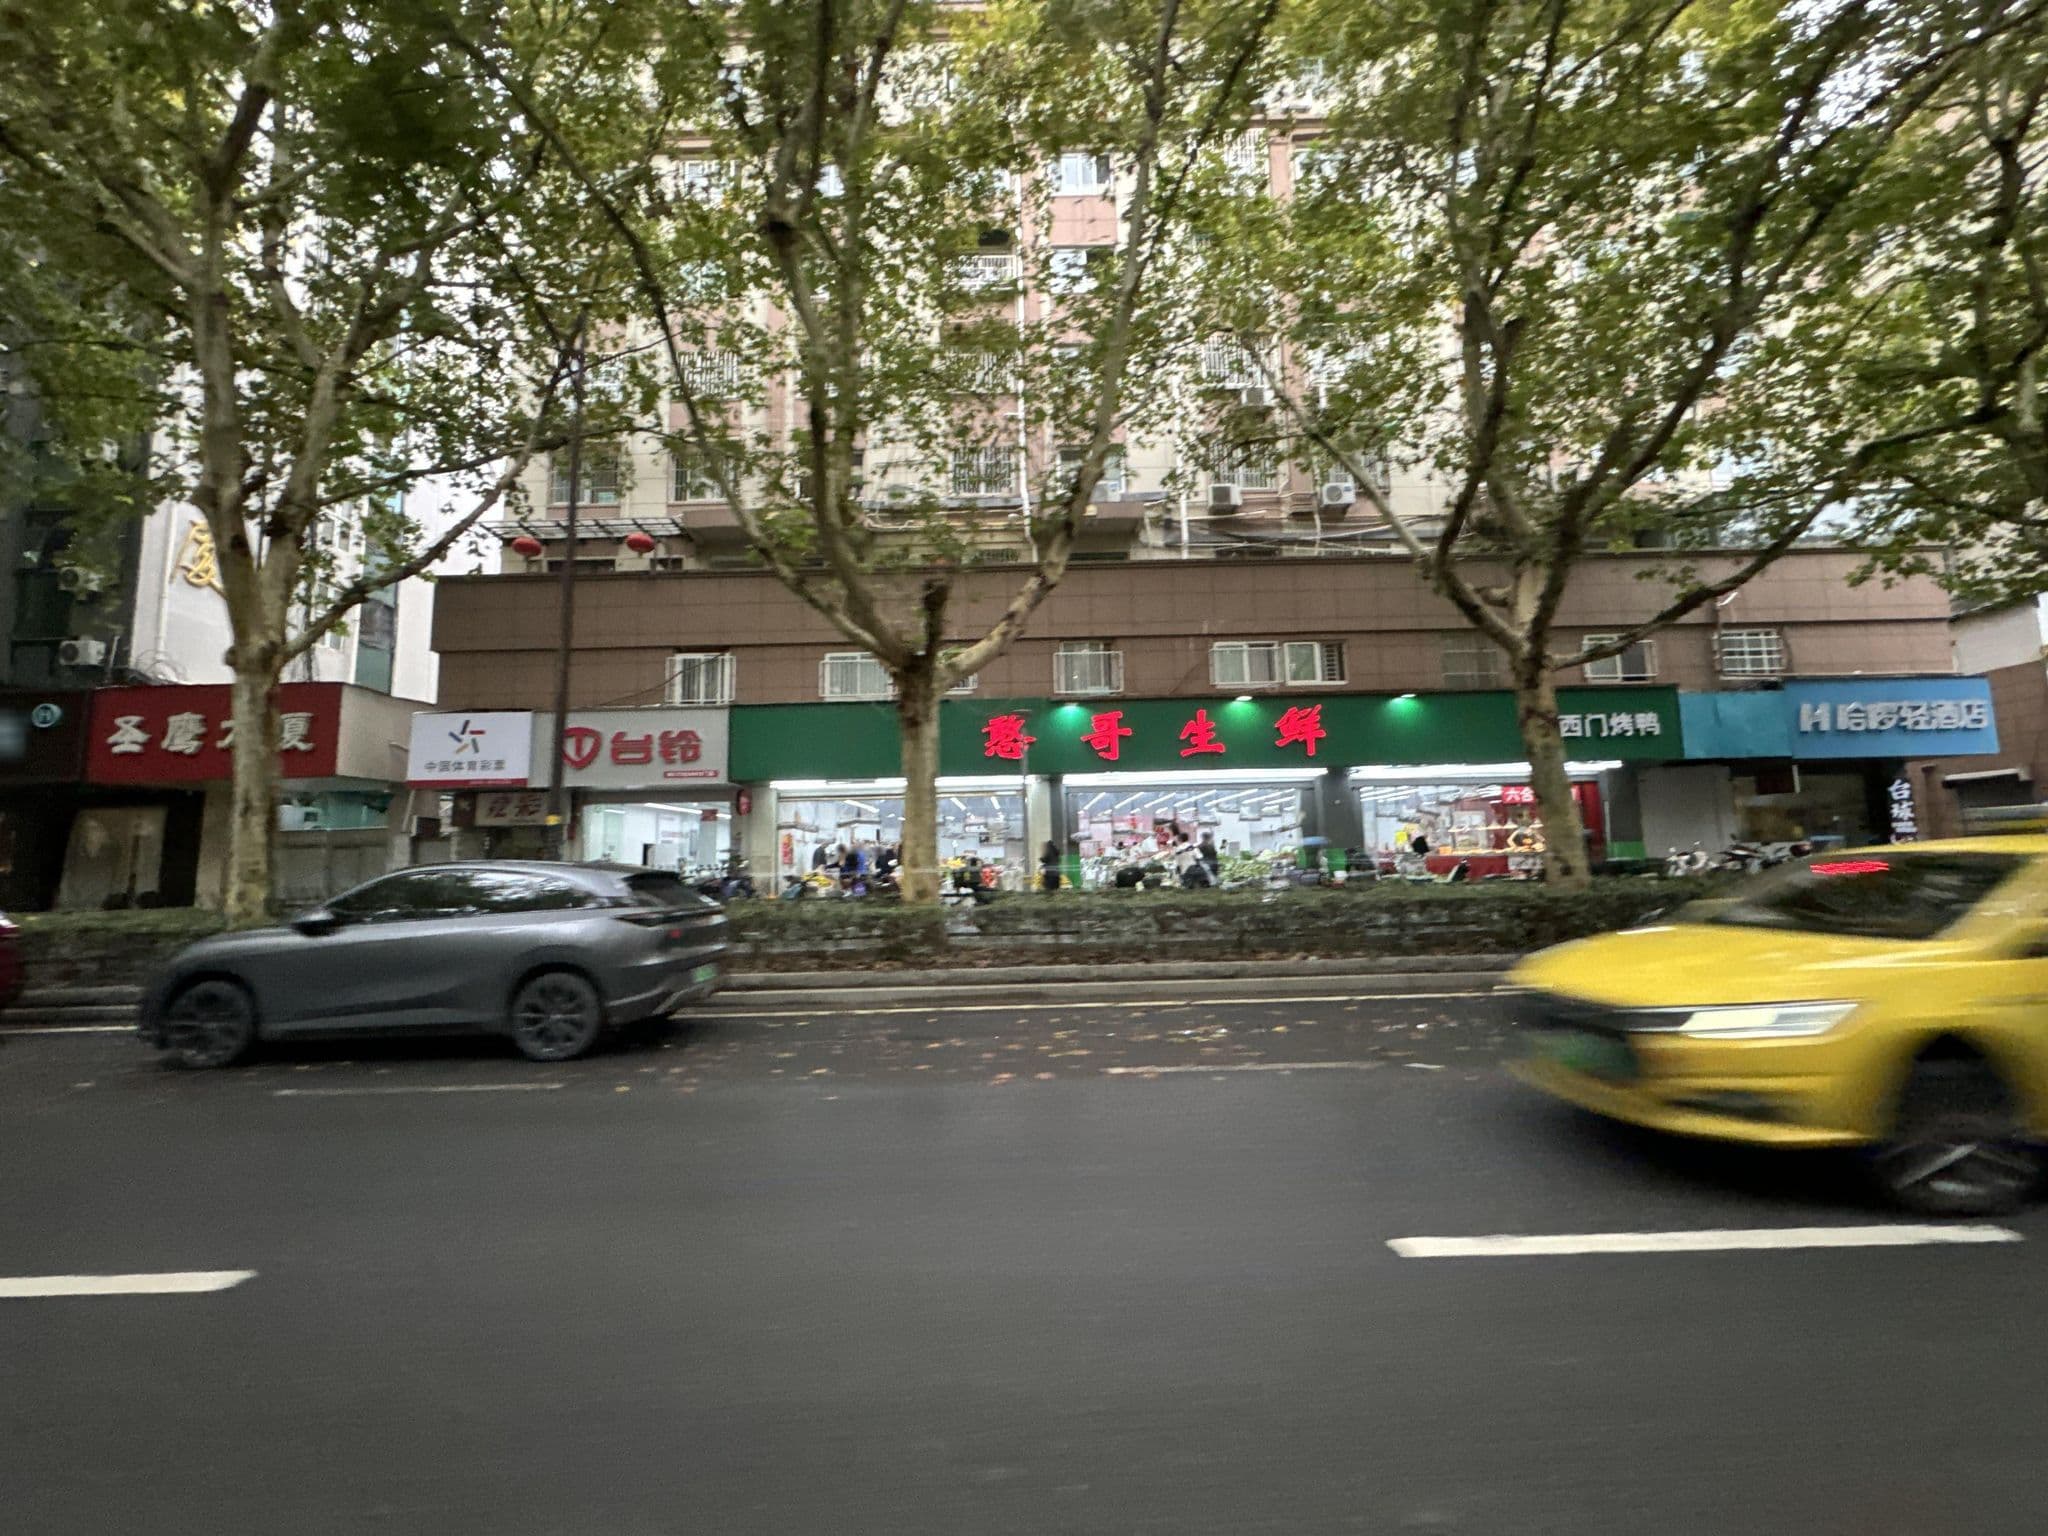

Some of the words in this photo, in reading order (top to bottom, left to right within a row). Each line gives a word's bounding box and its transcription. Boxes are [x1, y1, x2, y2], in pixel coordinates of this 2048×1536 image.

[982, 704, 1327, 760] 憨哥生鲜
[1557, 712, 1660, 737] 西门烤鸭
[611, 729, 702, 765] 台铃
[424, 759, 505, 773] 中国体育彩票
